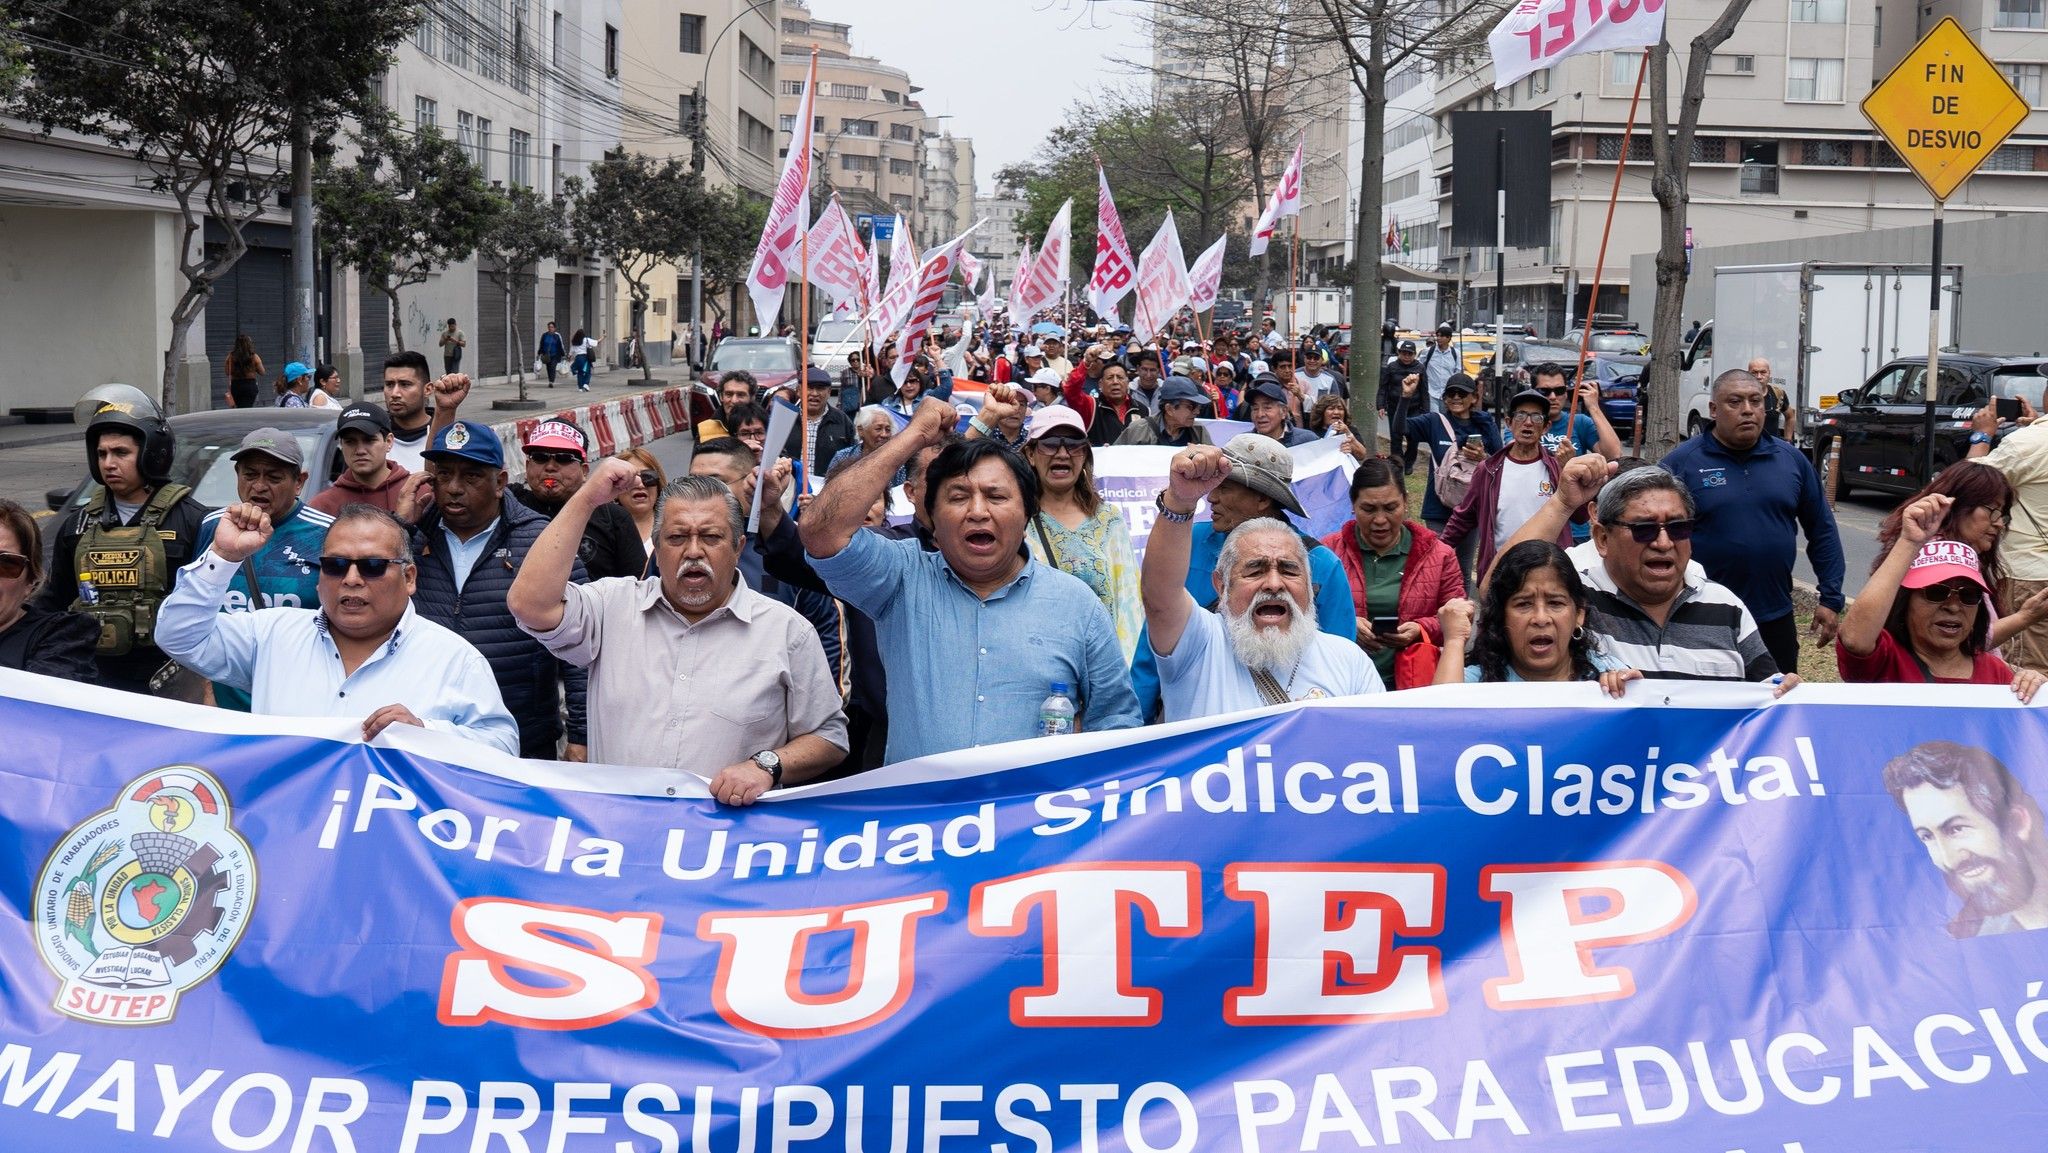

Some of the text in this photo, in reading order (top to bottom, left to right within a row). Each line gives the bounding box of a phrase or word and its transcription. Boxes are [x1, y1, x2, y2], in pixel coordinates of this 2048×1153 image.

[1926, 64, 1964, 83] FIN
[1932, 96, 1959, 114] DE
[1907, 129, 1981, 149] DESVIO
[1917, 555, 1949, 566] DEFENSA
[1950, 555, 1963, 564] DEL
[92, 570, 136, 584] POLICIA
[317, 736, 1826, 881] ¡Por la Unidad Sindical Clasista!
[234, 861, 243, 870] LA
[47, 819, 120, 971] SINDICATO UNITARIO DE TRABAJADORES
[105, 872, 129, 930] POR LA UNIDAD
[228, 873, 245, 922] EDUCACIÓN
[151, 908, 184, 936] CLASISTA
[217, 927, 231, 943] DEL
[437, 861, 1699, 1039] SUTEP
[130, 967, 152, 976] LUCHAR
[66, 986, 167, 1018] SUTEP
[0, 1043, 369, 1153] MAYOR
[398, 1080, 1199, 1153] PRESUPUESTO
[1232, 1060, 1529, 1153] PARA
